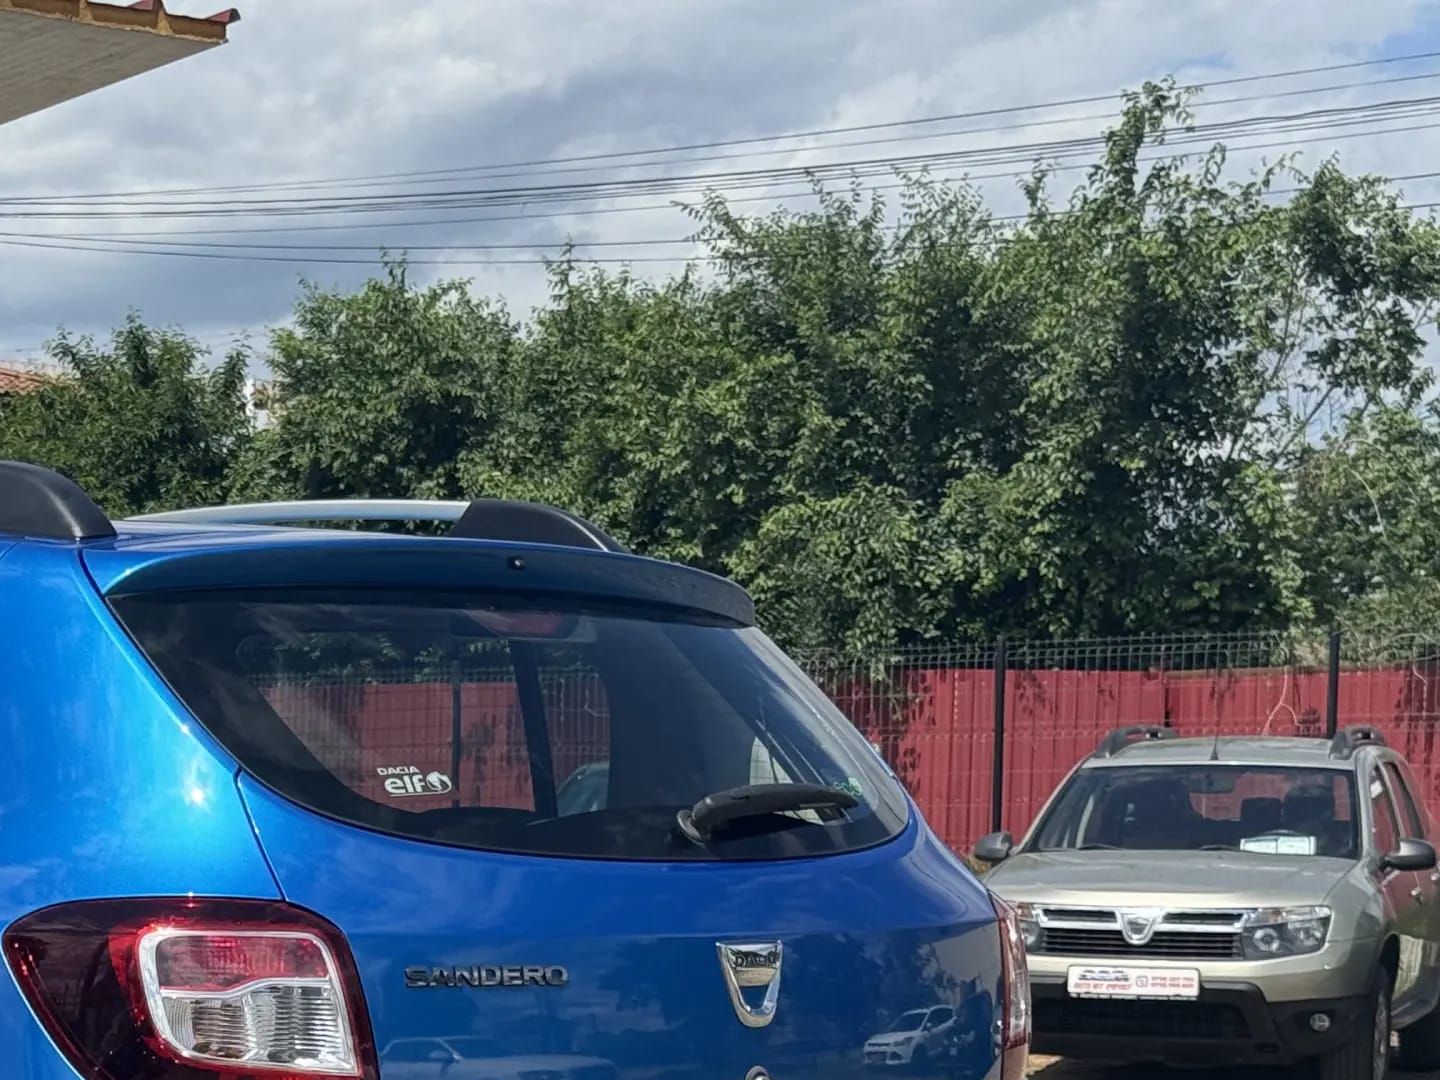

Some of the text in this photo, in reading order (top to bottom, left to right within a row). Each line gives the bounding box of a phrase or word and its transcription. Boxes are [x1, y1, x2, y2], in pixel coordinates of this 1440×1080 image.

[376, 766, 420, 776] DACIA
[384, 775, 425, 794] elf
[405, 965, 569, 987] SANDERO
